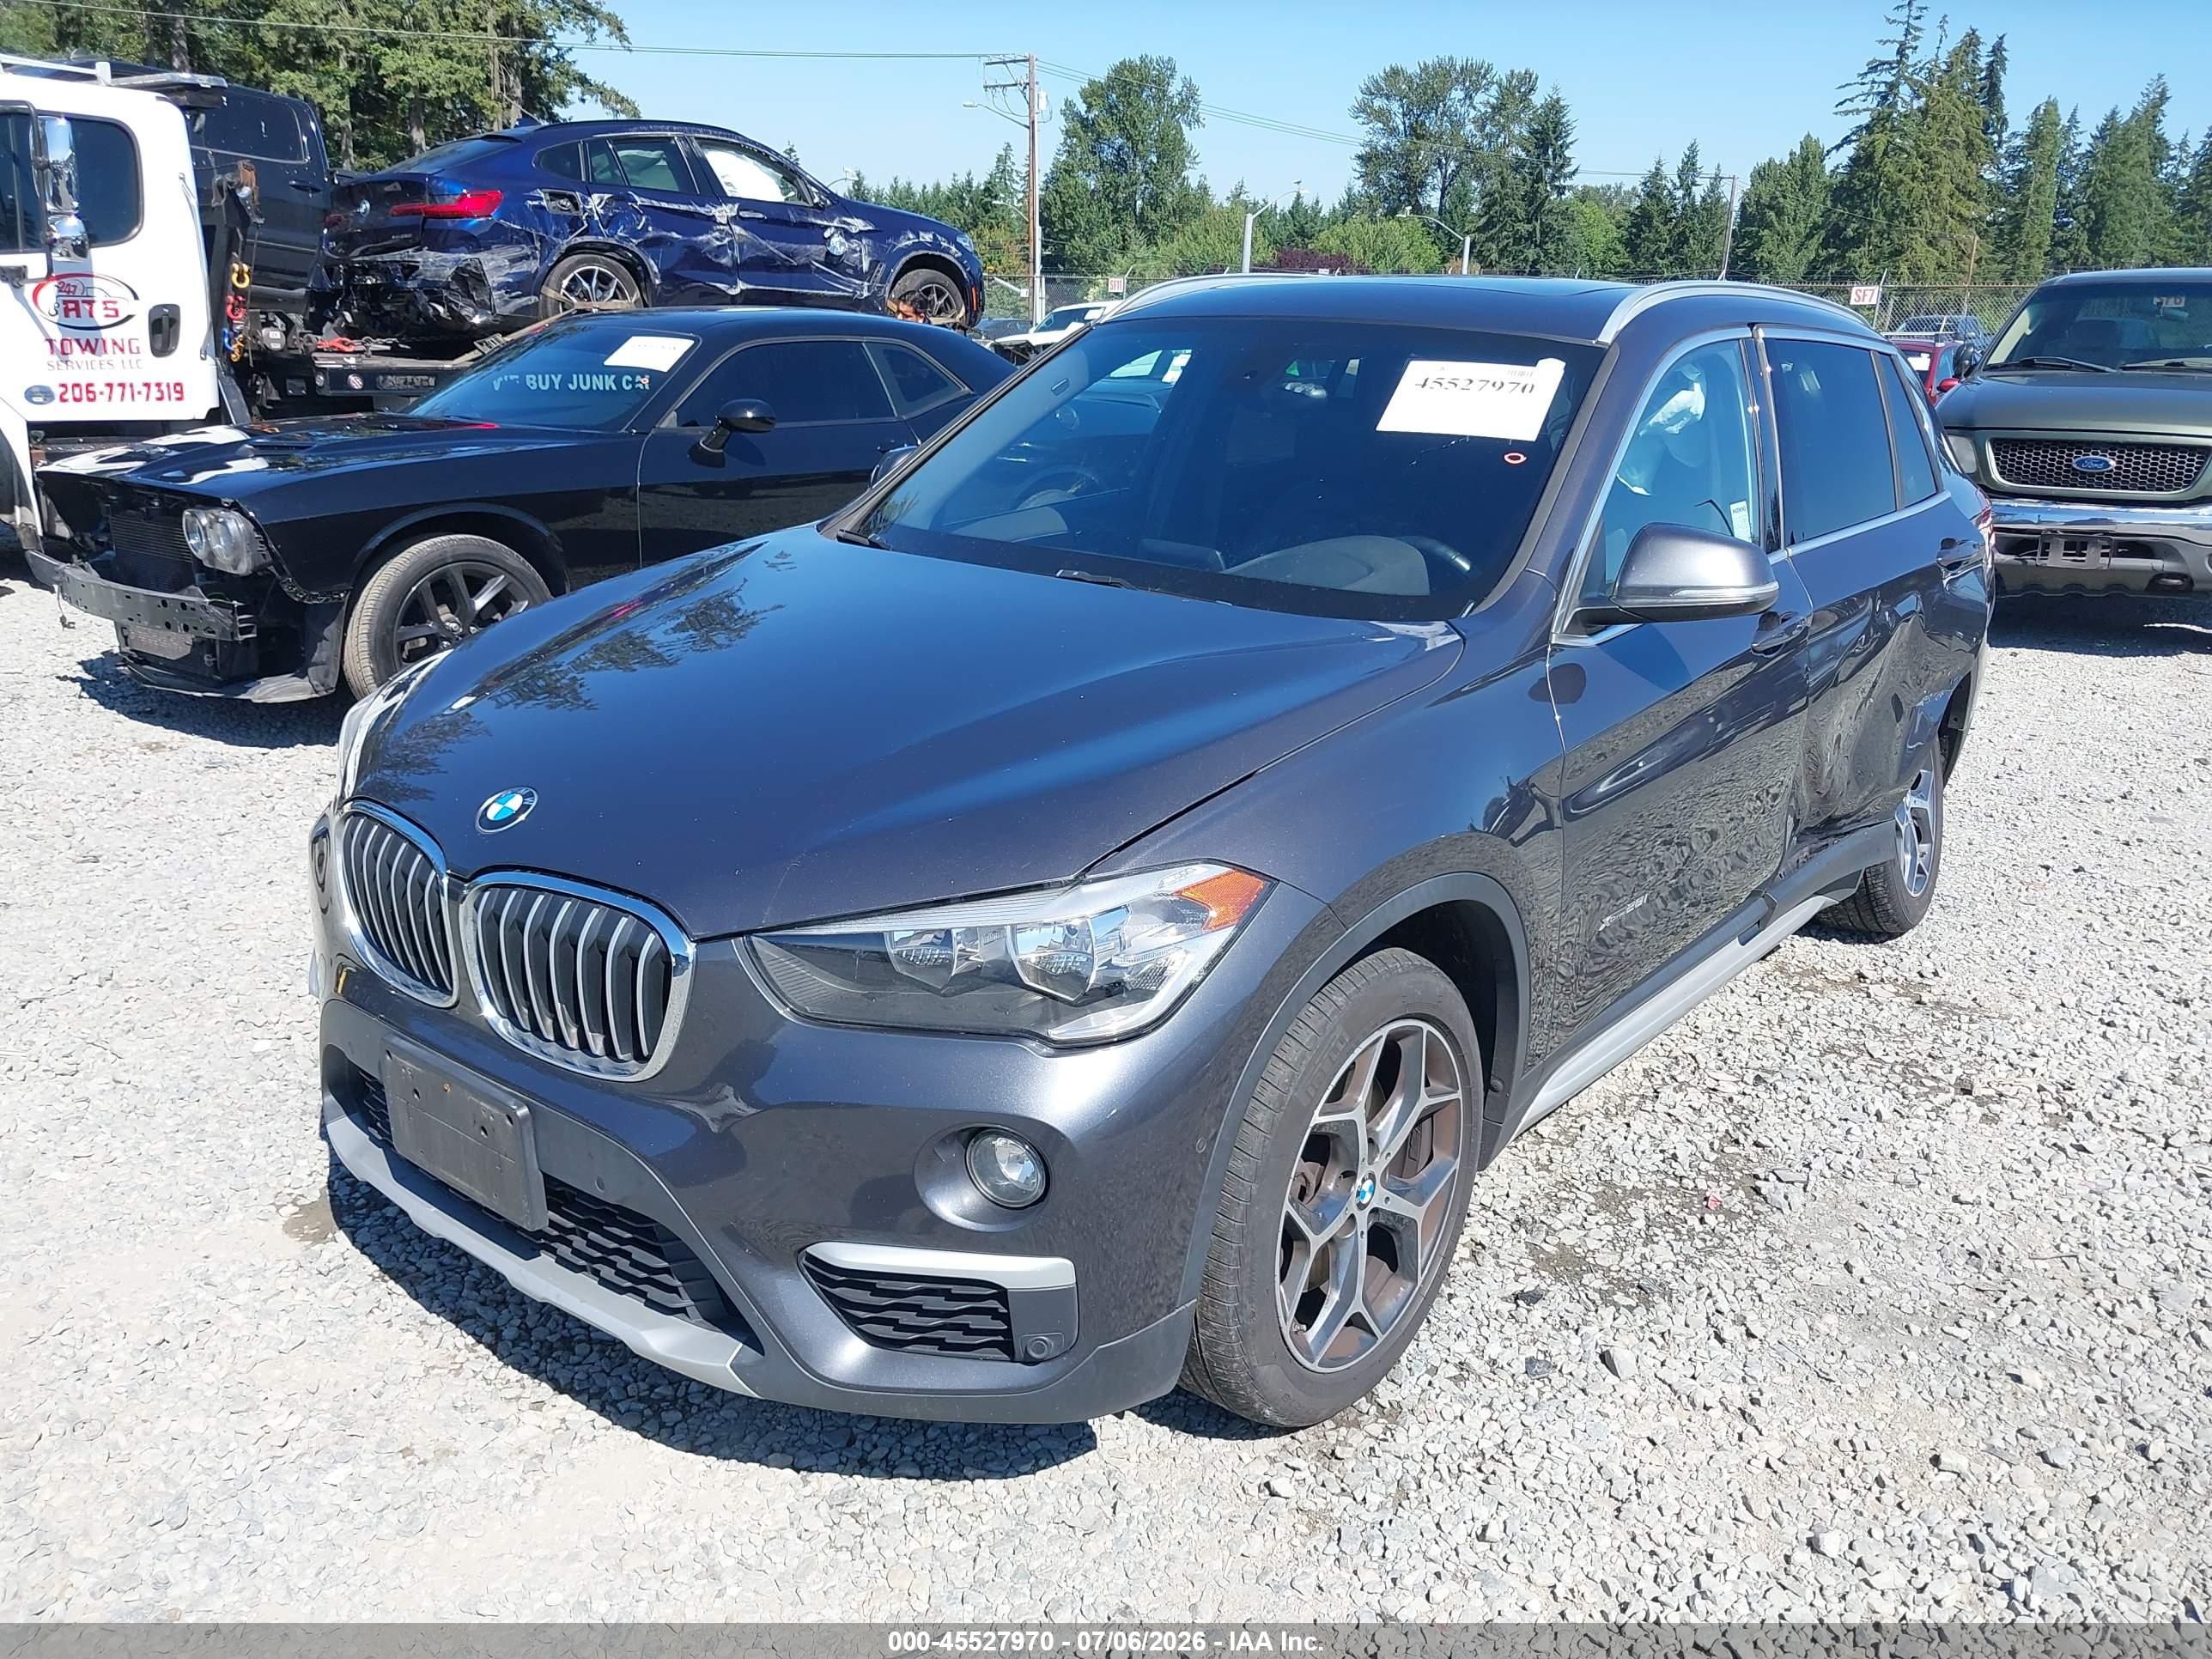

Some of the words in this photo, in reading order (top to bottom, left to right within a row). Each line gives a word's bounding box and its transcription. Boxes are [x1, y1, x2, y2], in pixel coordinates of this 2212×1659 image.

[1854, 289, 1875, 302] SF7
[45, 338, 141, 356] TOWING
[526, 374, 562, 391] BUY
[568, 374, 617, 391] JUNK
[58, 382, 185, 403] 206-771-7319
[2081, 459, 2105, 469] Ford
